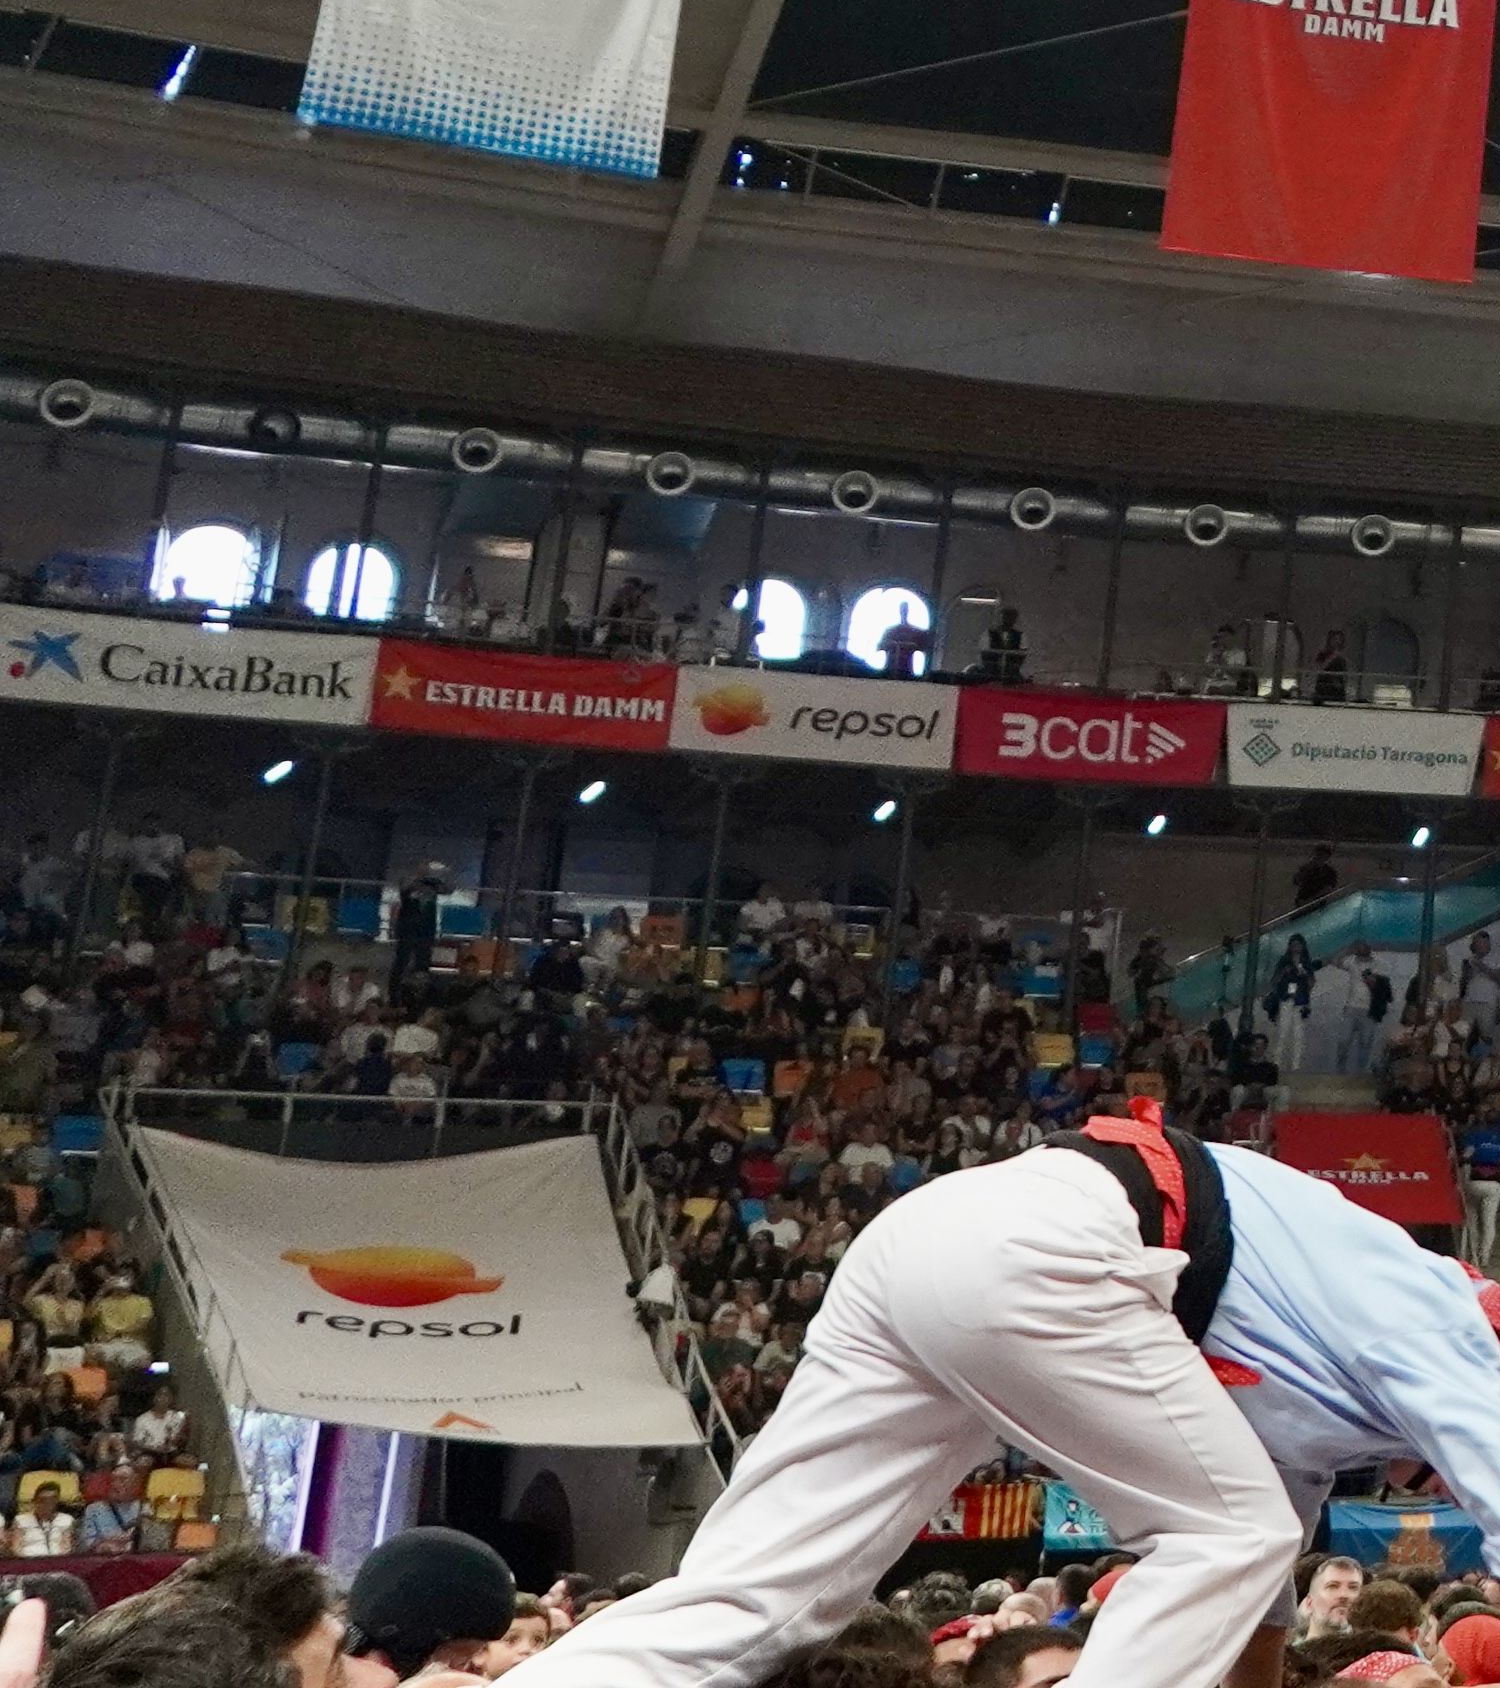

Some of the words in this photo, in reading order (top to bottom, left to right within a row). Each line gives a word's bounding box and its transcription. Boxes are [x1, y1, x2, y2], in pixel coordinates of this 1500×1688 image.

[1303, 13, 1385, 43] DAMM
[99, 642, 355, 702] CaixaBank
[425, 680, 567, 717] ESTRELLA
[573, 693, 666, 725] DAMM
[789, 705, 940, 742] repsol
[999, 714, 1147, 765] 3cat
[1291, 742, 1377, 762] Diputació
[1380, 745, 1469, 768] Tarragona
[296, 1310, 523, 1339] repsol
